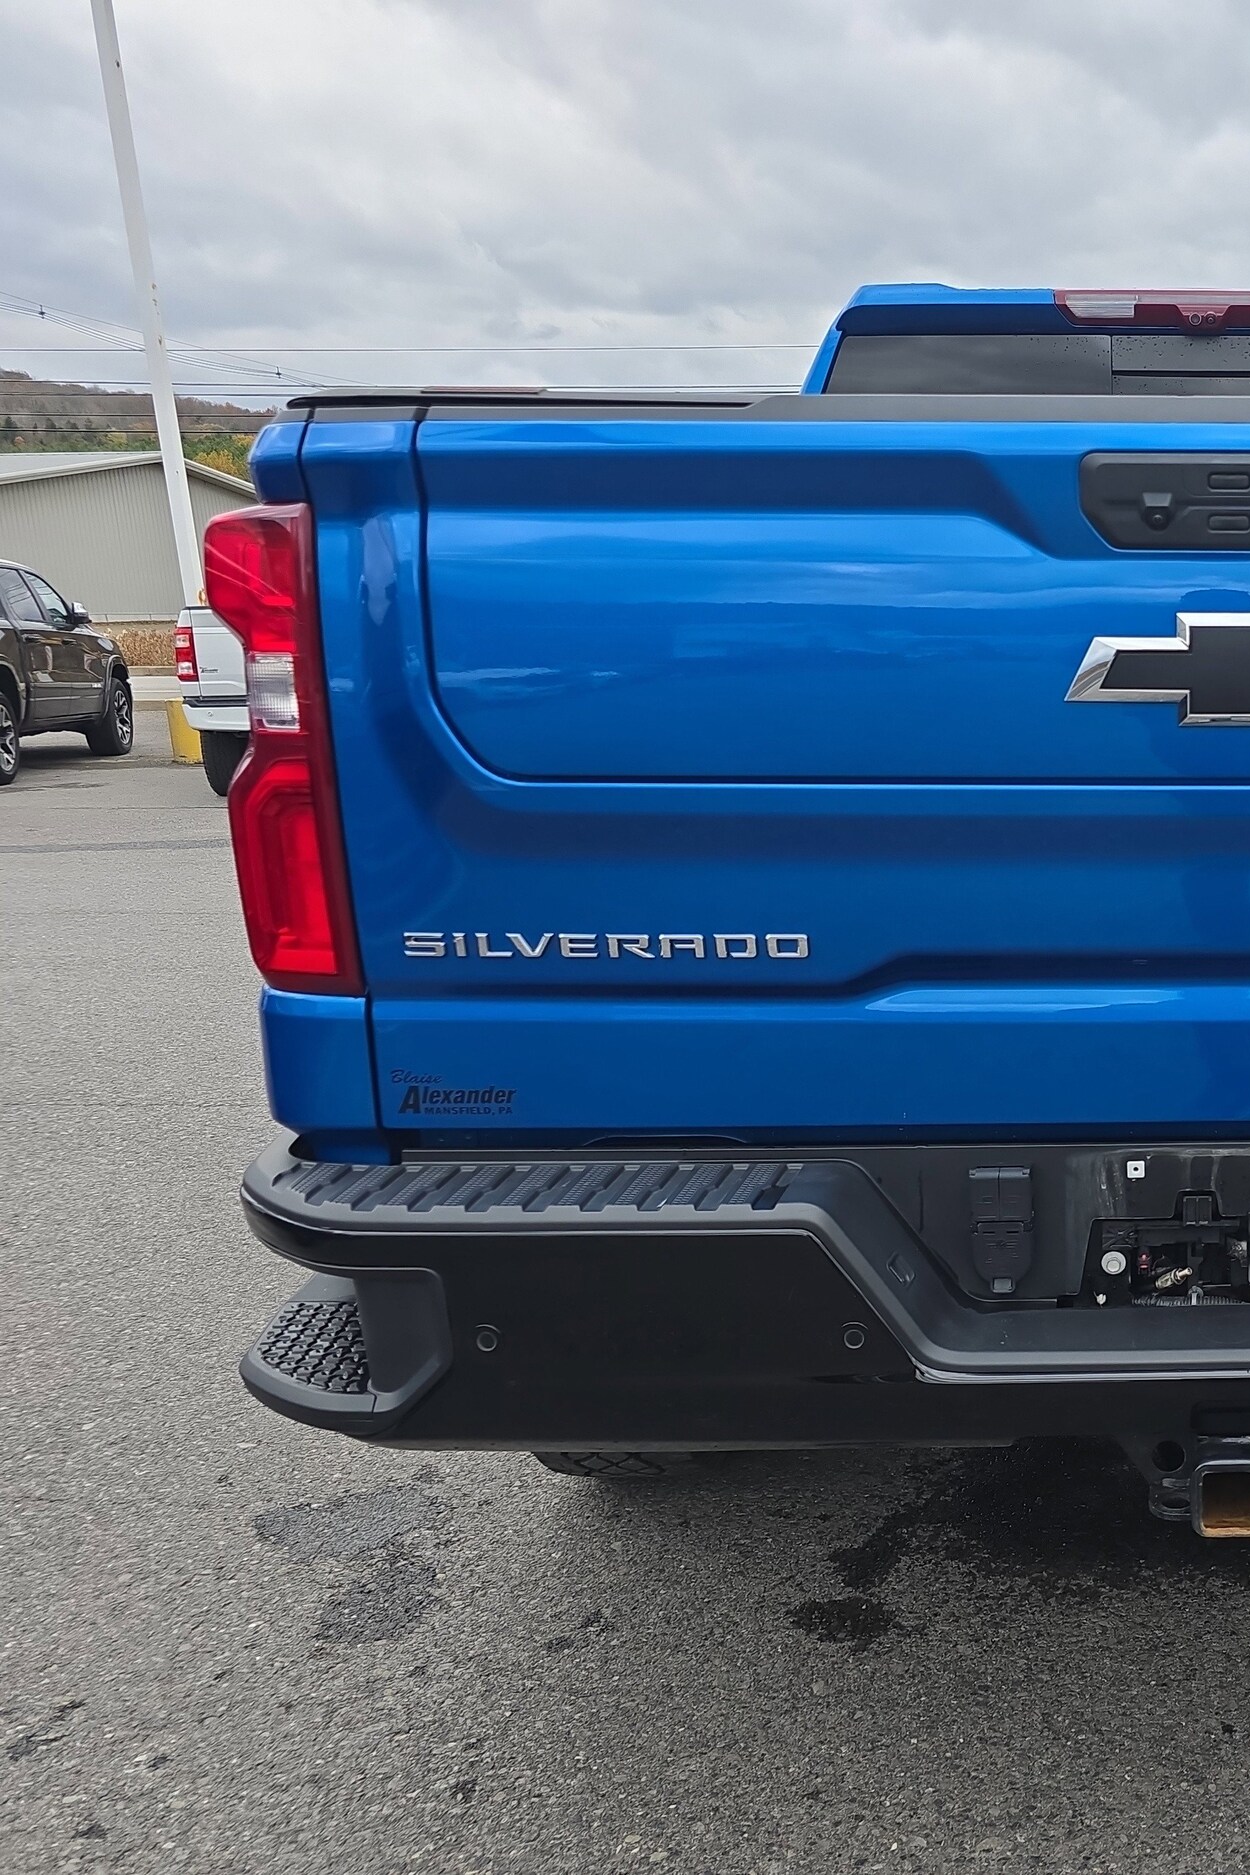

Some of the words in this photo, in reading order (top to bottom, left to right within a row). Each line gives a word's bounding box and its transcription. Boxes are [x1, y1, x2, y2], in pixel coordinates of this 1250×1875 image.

[402, 931, 810, 959] SILVERADO
[390, 1069, 442, 1083] Blaise
[398, 1085, 517, 1114] Alexander
[424, 1106, 496, 1115] MANSFIELD,
[498, 1106, 513, 1114] PA
